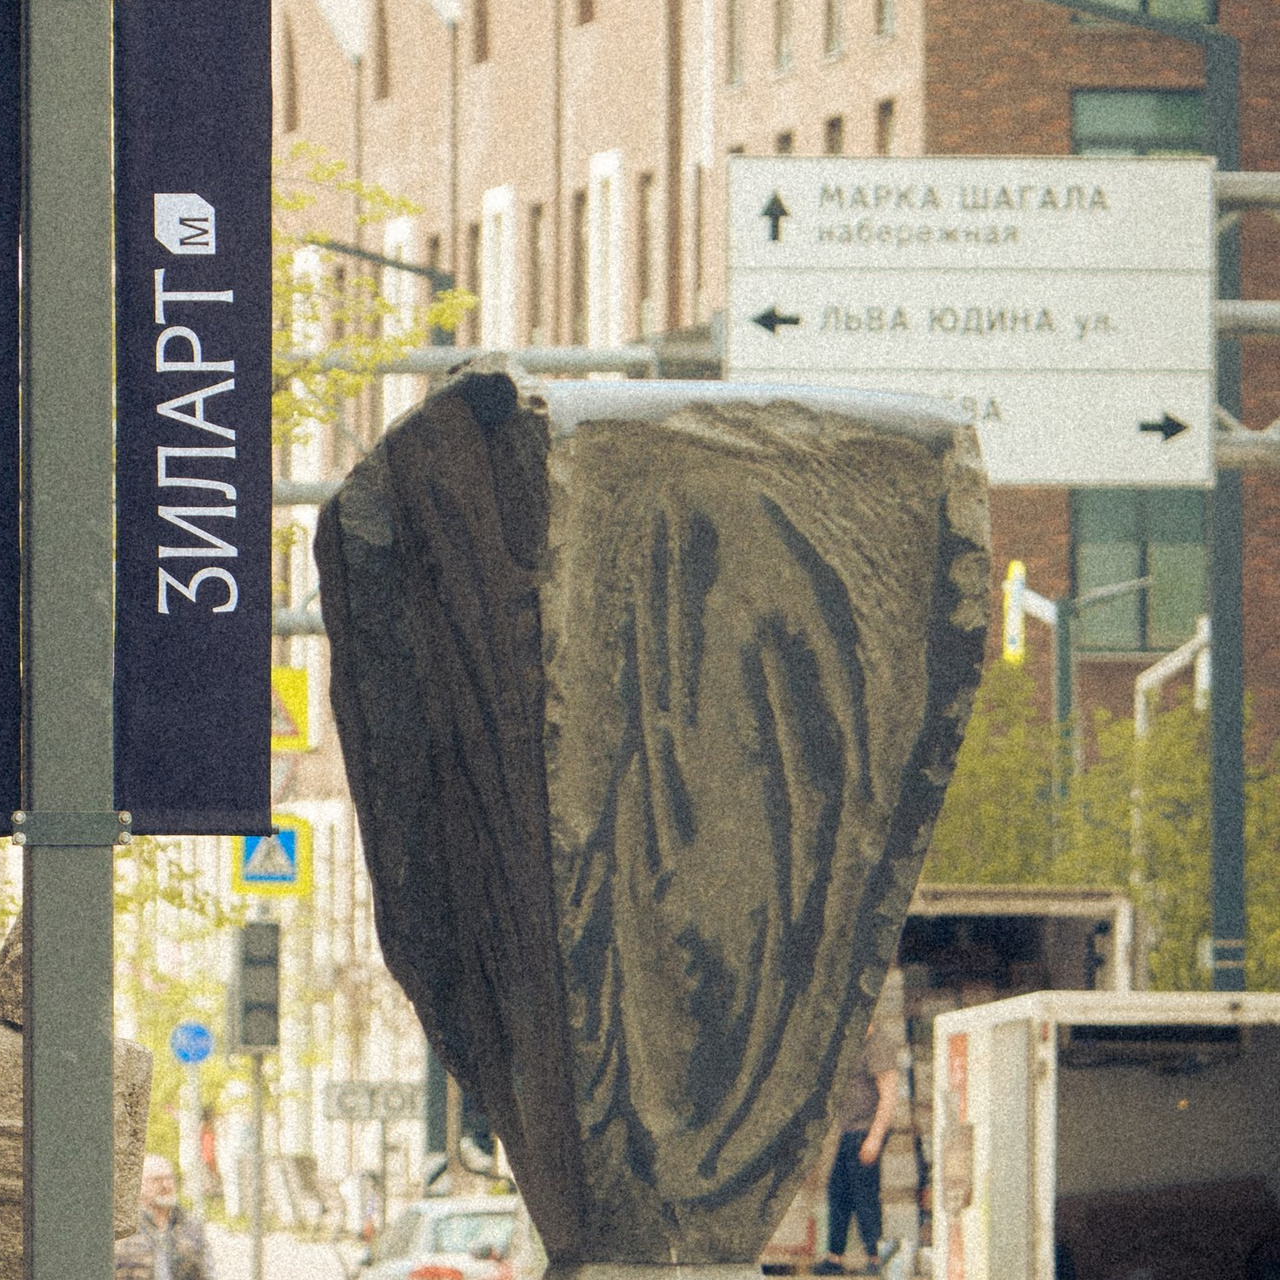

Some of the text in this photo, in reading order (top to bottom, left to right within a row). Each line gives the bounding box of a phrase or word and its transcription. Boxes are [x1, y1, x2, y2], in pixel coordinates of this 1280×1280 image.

[819, 183, 1110, 211] МАРКА ШАГАЛА
[819, 218, 1019, 247] набережная
[819, 305, 1118, 340] ЛЬВА ЮДИНА ул.
[153, 267, 239, 615] ЗИЛАРТ
